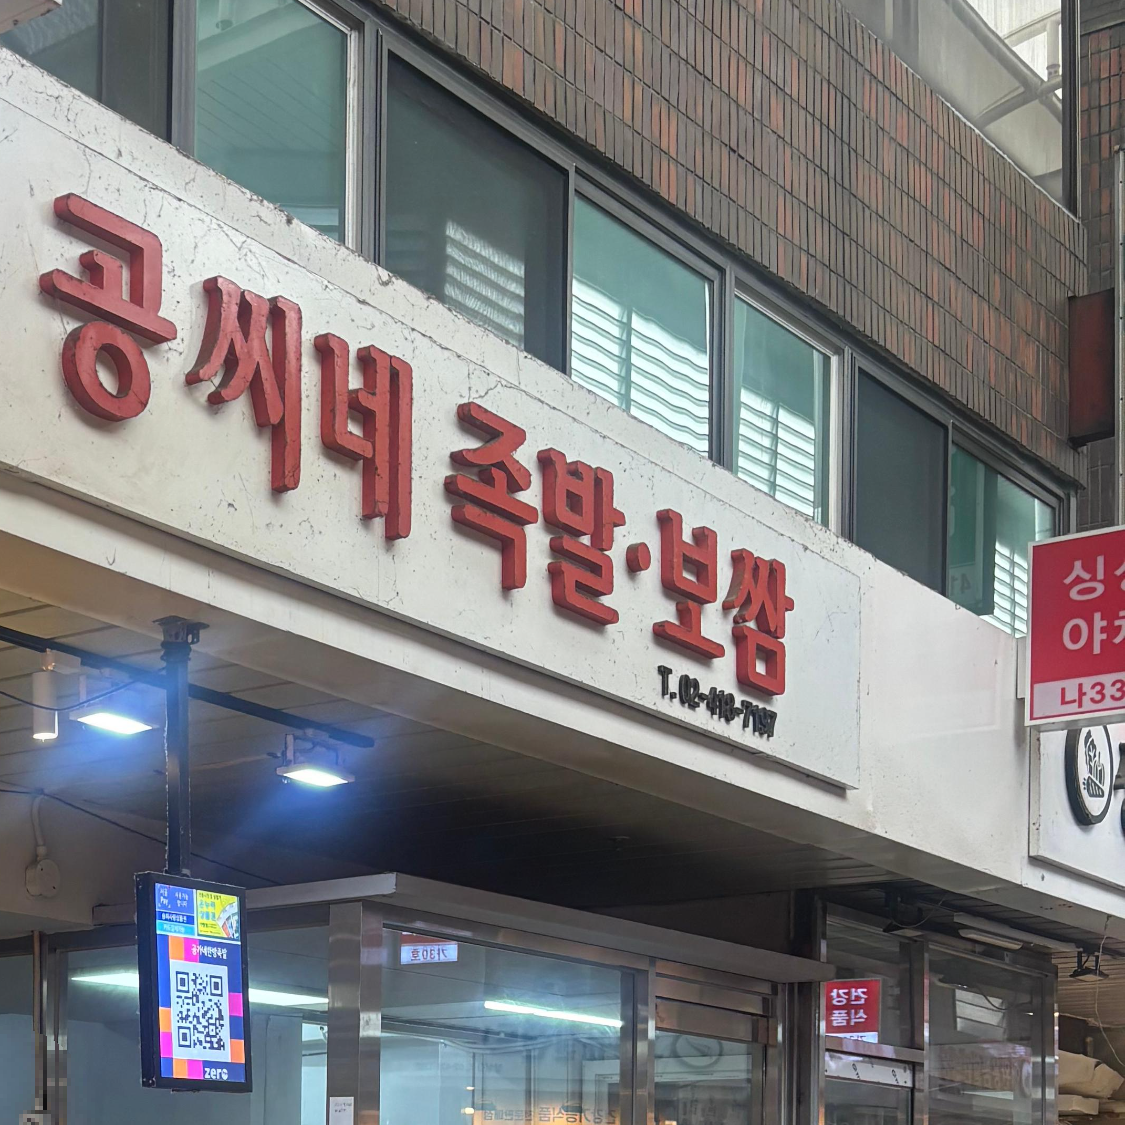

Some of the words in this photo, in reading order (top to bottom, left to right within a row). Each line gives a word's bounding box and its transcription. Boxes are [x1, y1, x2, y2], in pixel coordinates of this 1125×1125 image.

[39, 192, 413, 541] 공씨네
[444, 401, 795, 697] 족발·보쌈
[1063, 555, 1125, 601] 싱
